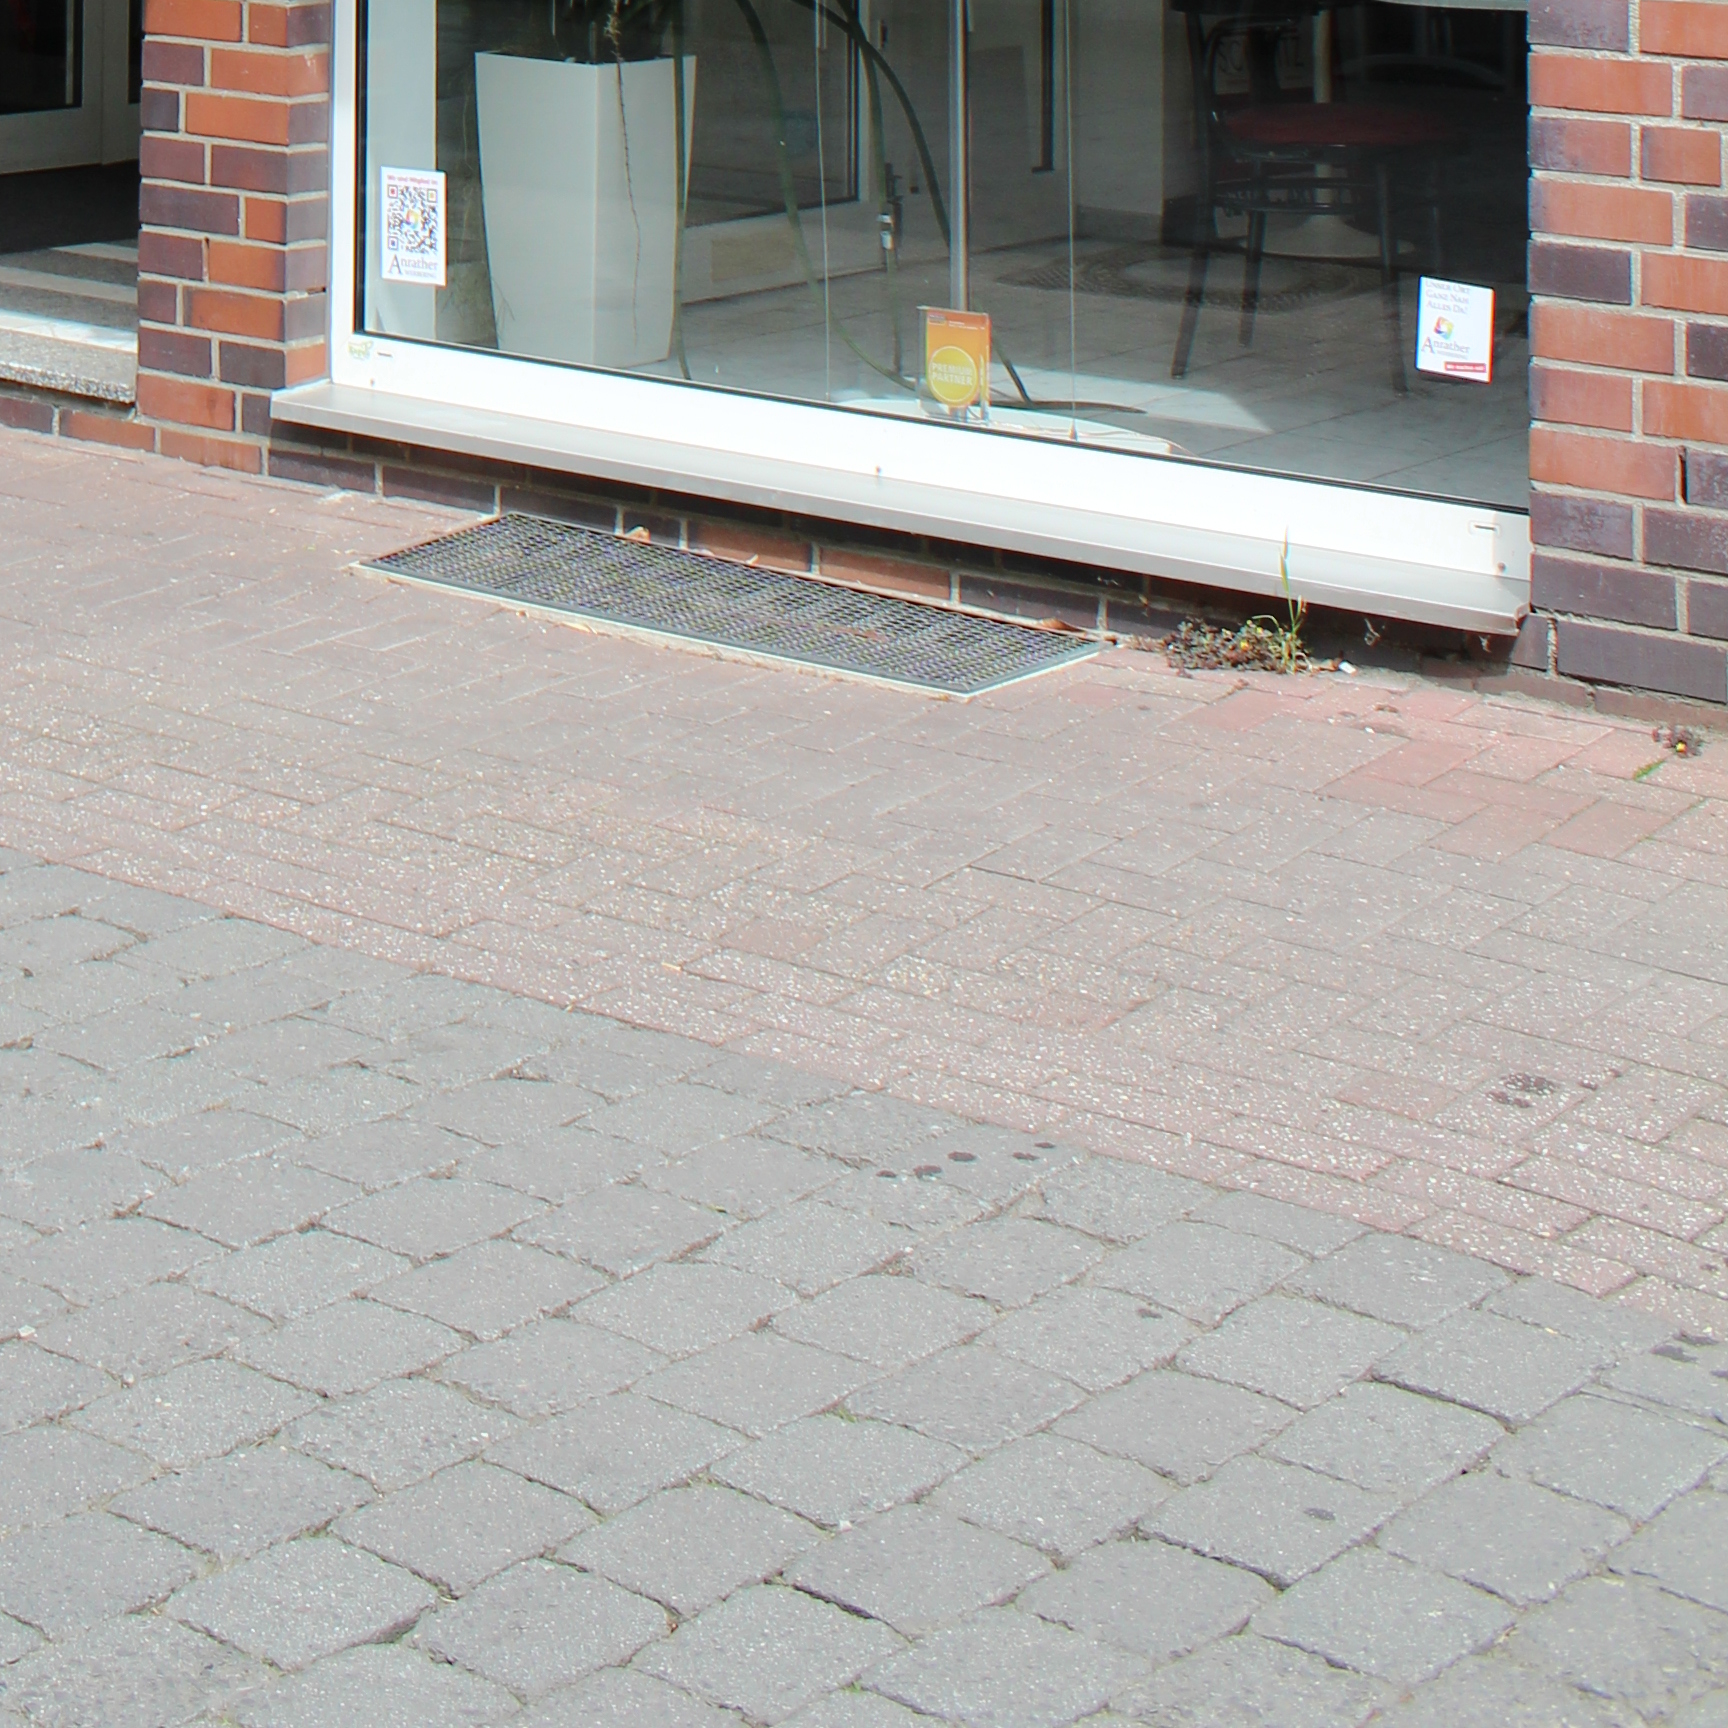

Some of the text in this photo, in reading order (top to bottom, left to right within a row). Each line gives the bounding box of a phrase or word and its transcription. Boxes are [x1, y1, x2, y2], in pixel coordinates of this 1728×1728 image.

[387, 253, 438, 275] Anrather
[1421, 336, 1471, 355] Anrather
[931, 362, 973, 376] PREMIUM
[931, 372, 973, 386] PARTNER
